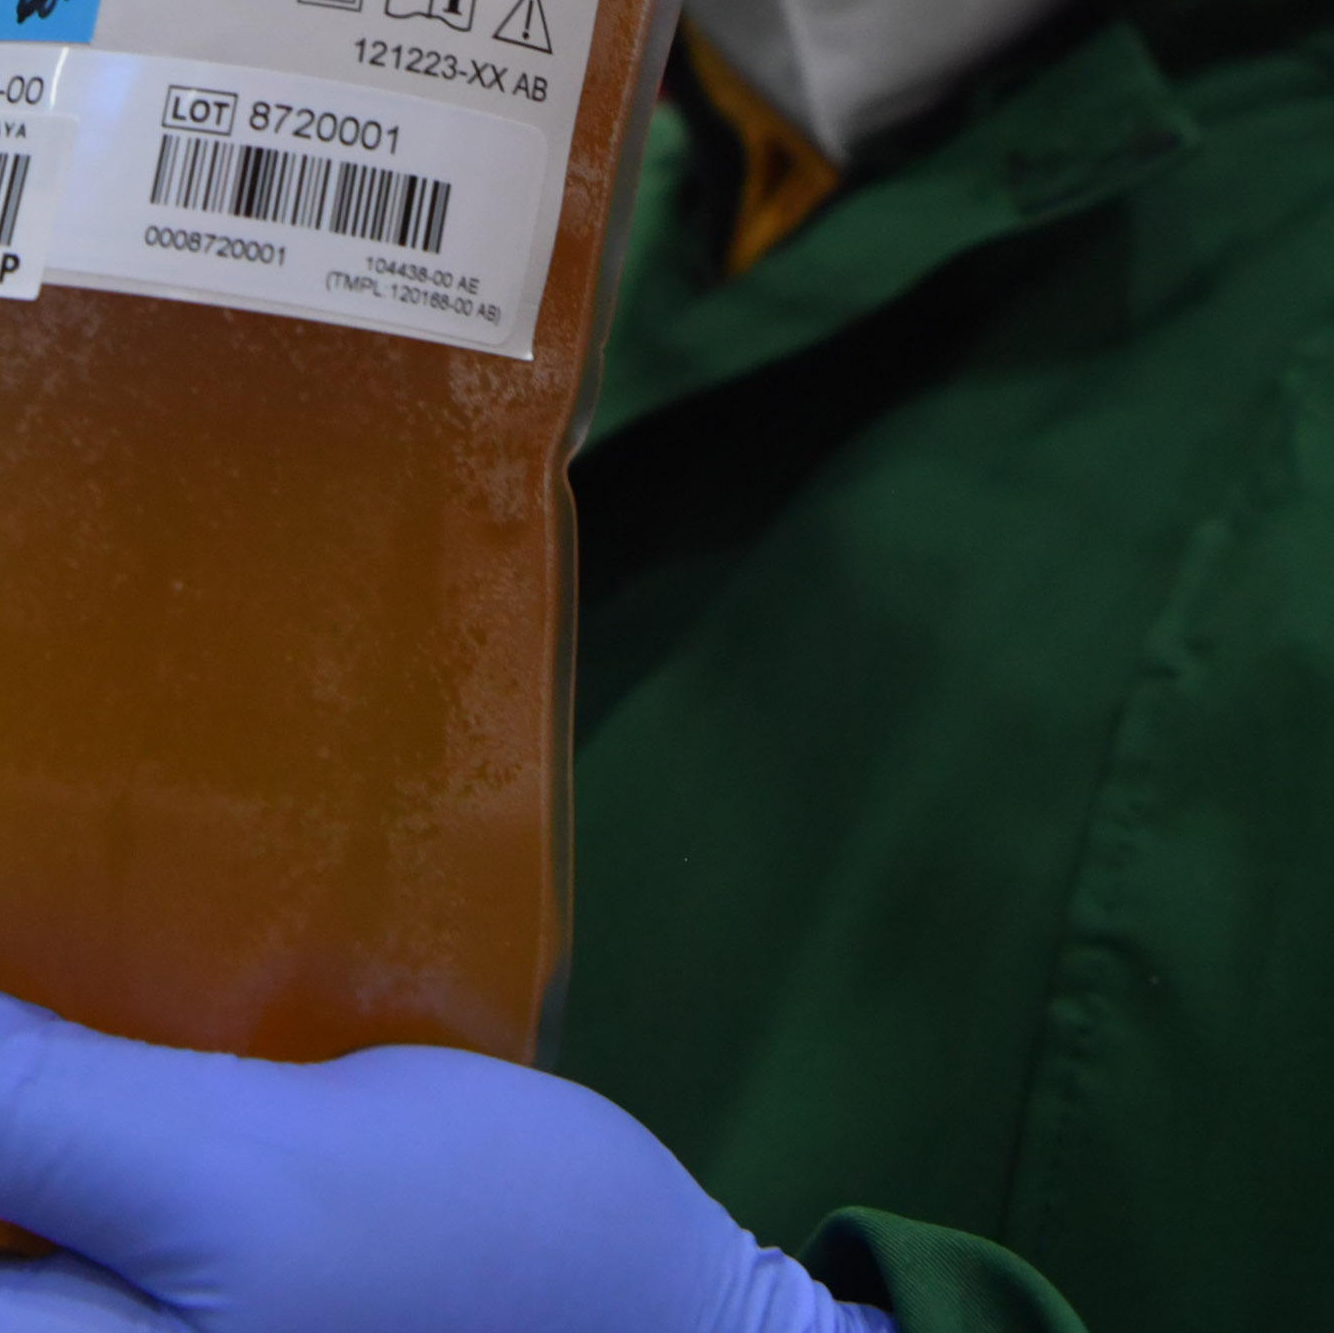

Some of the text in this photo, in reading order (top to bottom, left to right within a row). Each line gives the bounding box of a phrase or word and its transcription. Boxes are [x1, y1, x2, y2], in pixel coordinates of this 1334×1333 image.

[354, 38, 548, 103] 121223-XX AB
[171, 96, 400, 156] LOT 8720001
[144, 224, 287, 267] 0008720001
[365, 256, 481, 296] 104438-00 AE
